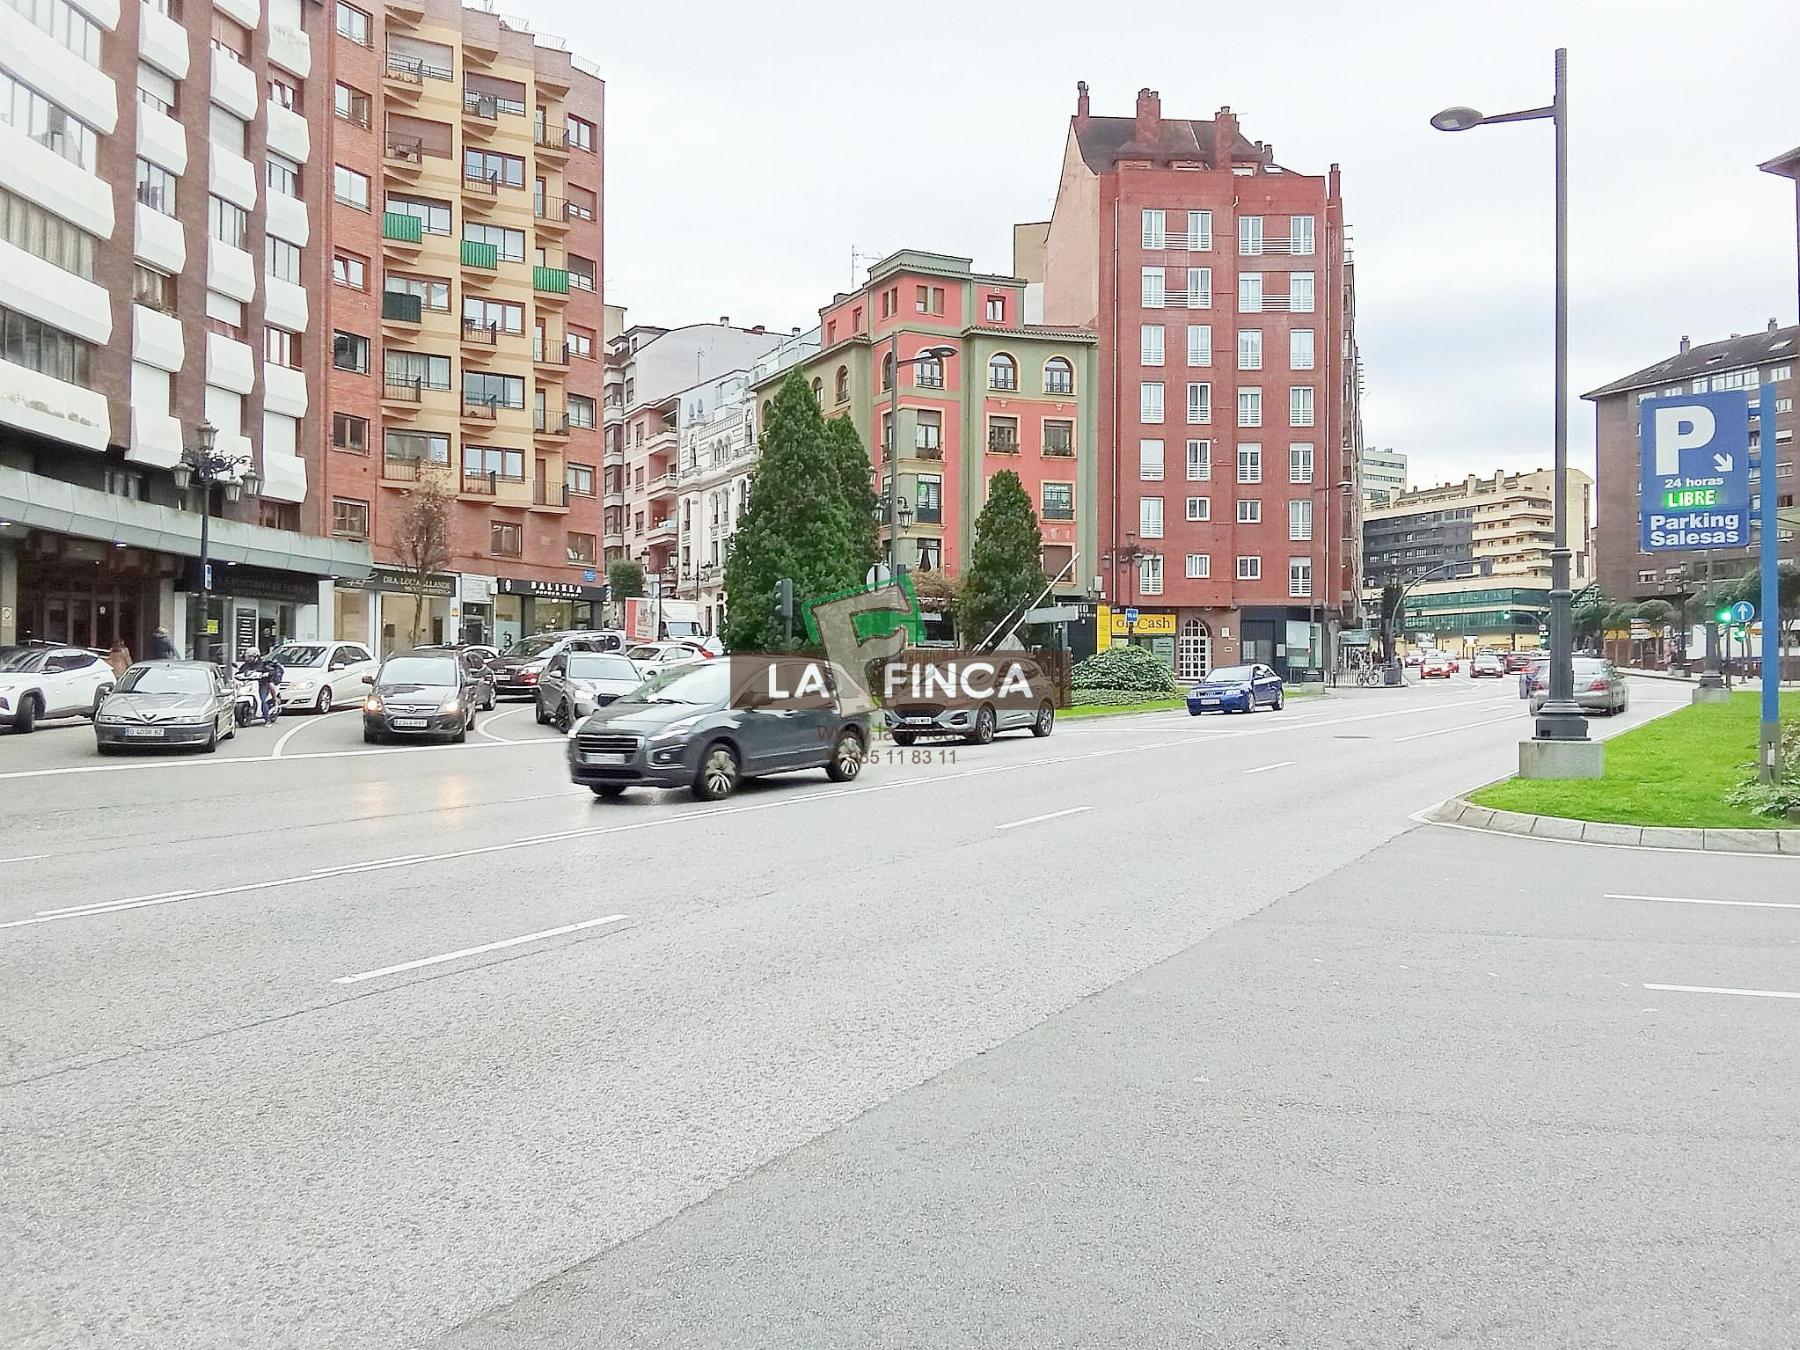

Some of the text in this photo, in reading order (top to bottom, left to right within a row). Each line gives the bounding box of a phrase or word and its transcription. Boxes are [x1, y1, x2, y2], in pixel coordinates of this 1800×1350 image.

[1656, 405, 1716, 476] P
[1664, 477, 1724, 488] 24 horas
[1668, 490, 1716, 507] LIBRE
[1650, 512, 1739, 531] Parking
[1650, 530, 1739, 546] Salesas
